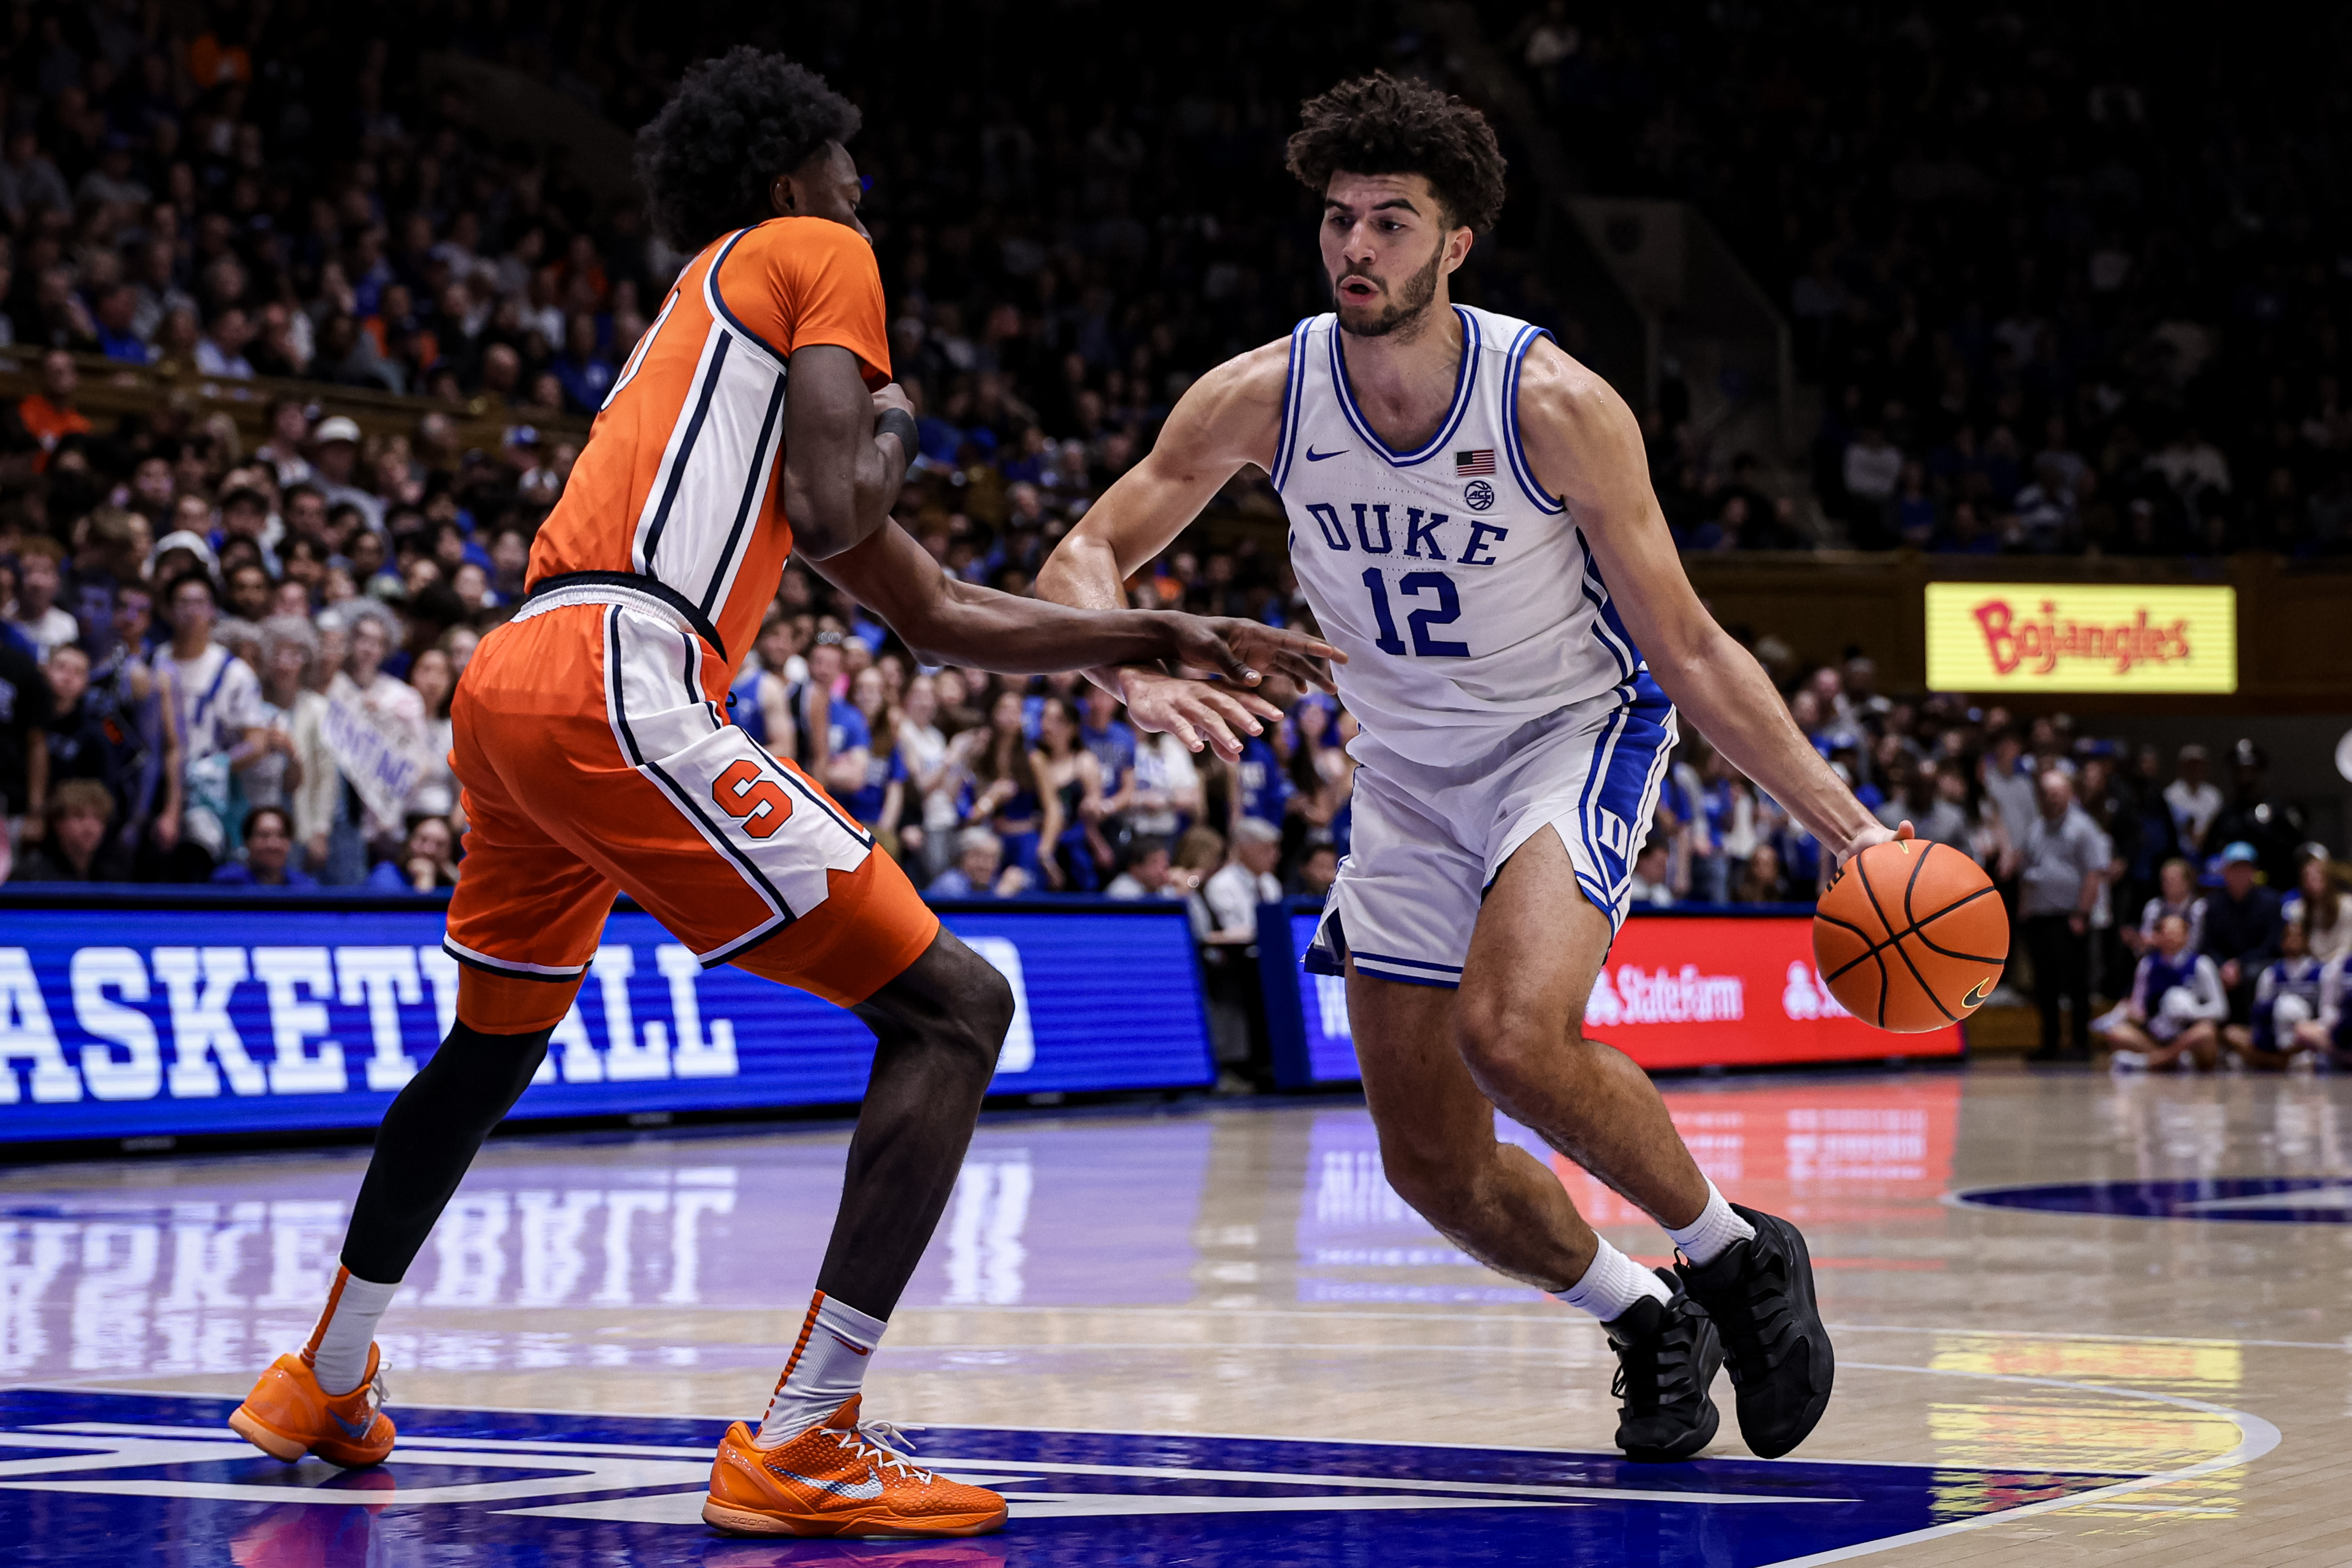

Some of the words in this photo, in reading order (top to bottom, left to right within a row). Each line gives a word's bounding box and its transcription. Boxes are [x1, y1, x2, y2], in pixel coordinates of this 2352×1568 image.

[1469, 490, 1492, 499] ACC
[1305, 503, 1509, 565] DUKE
[1362, 567, 1471, 657] 12
[1974, 600, 2189, 675] Bojangles
[712, 759, 793, 839] S
